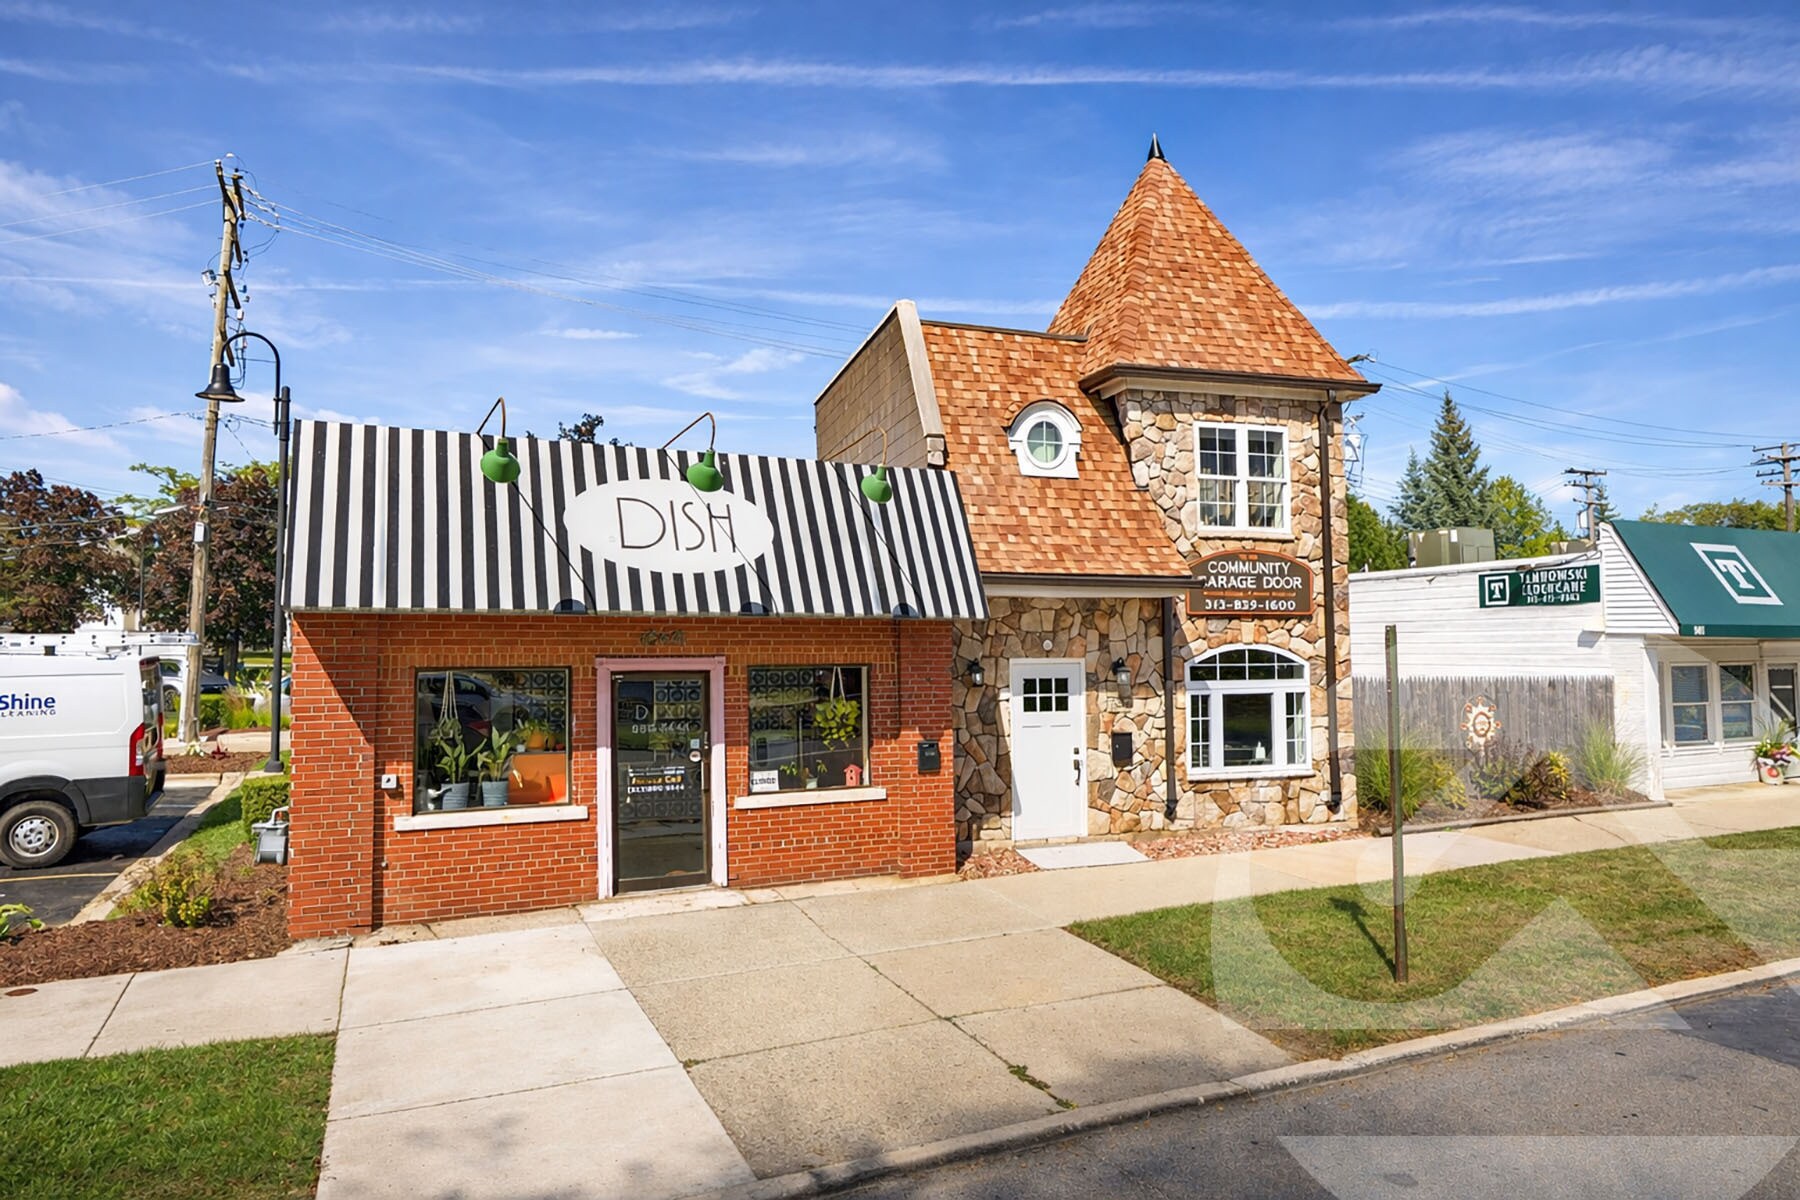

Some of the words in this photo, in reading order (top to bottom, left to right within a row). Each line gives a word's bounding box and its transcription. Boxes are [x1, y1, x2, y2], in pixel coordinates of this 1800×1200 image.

[616, 496, 736, 553] DISH
[1207, 560, 1291, 575] COMMUNITY
[1713, 558, 1756, 589] T
[1263, 576, 1303, 589] DOOR
[1490, 582, 1504, 599] T
[0, 693, 56, 711] Shine
[0, 709, 57, 718] LEANING
